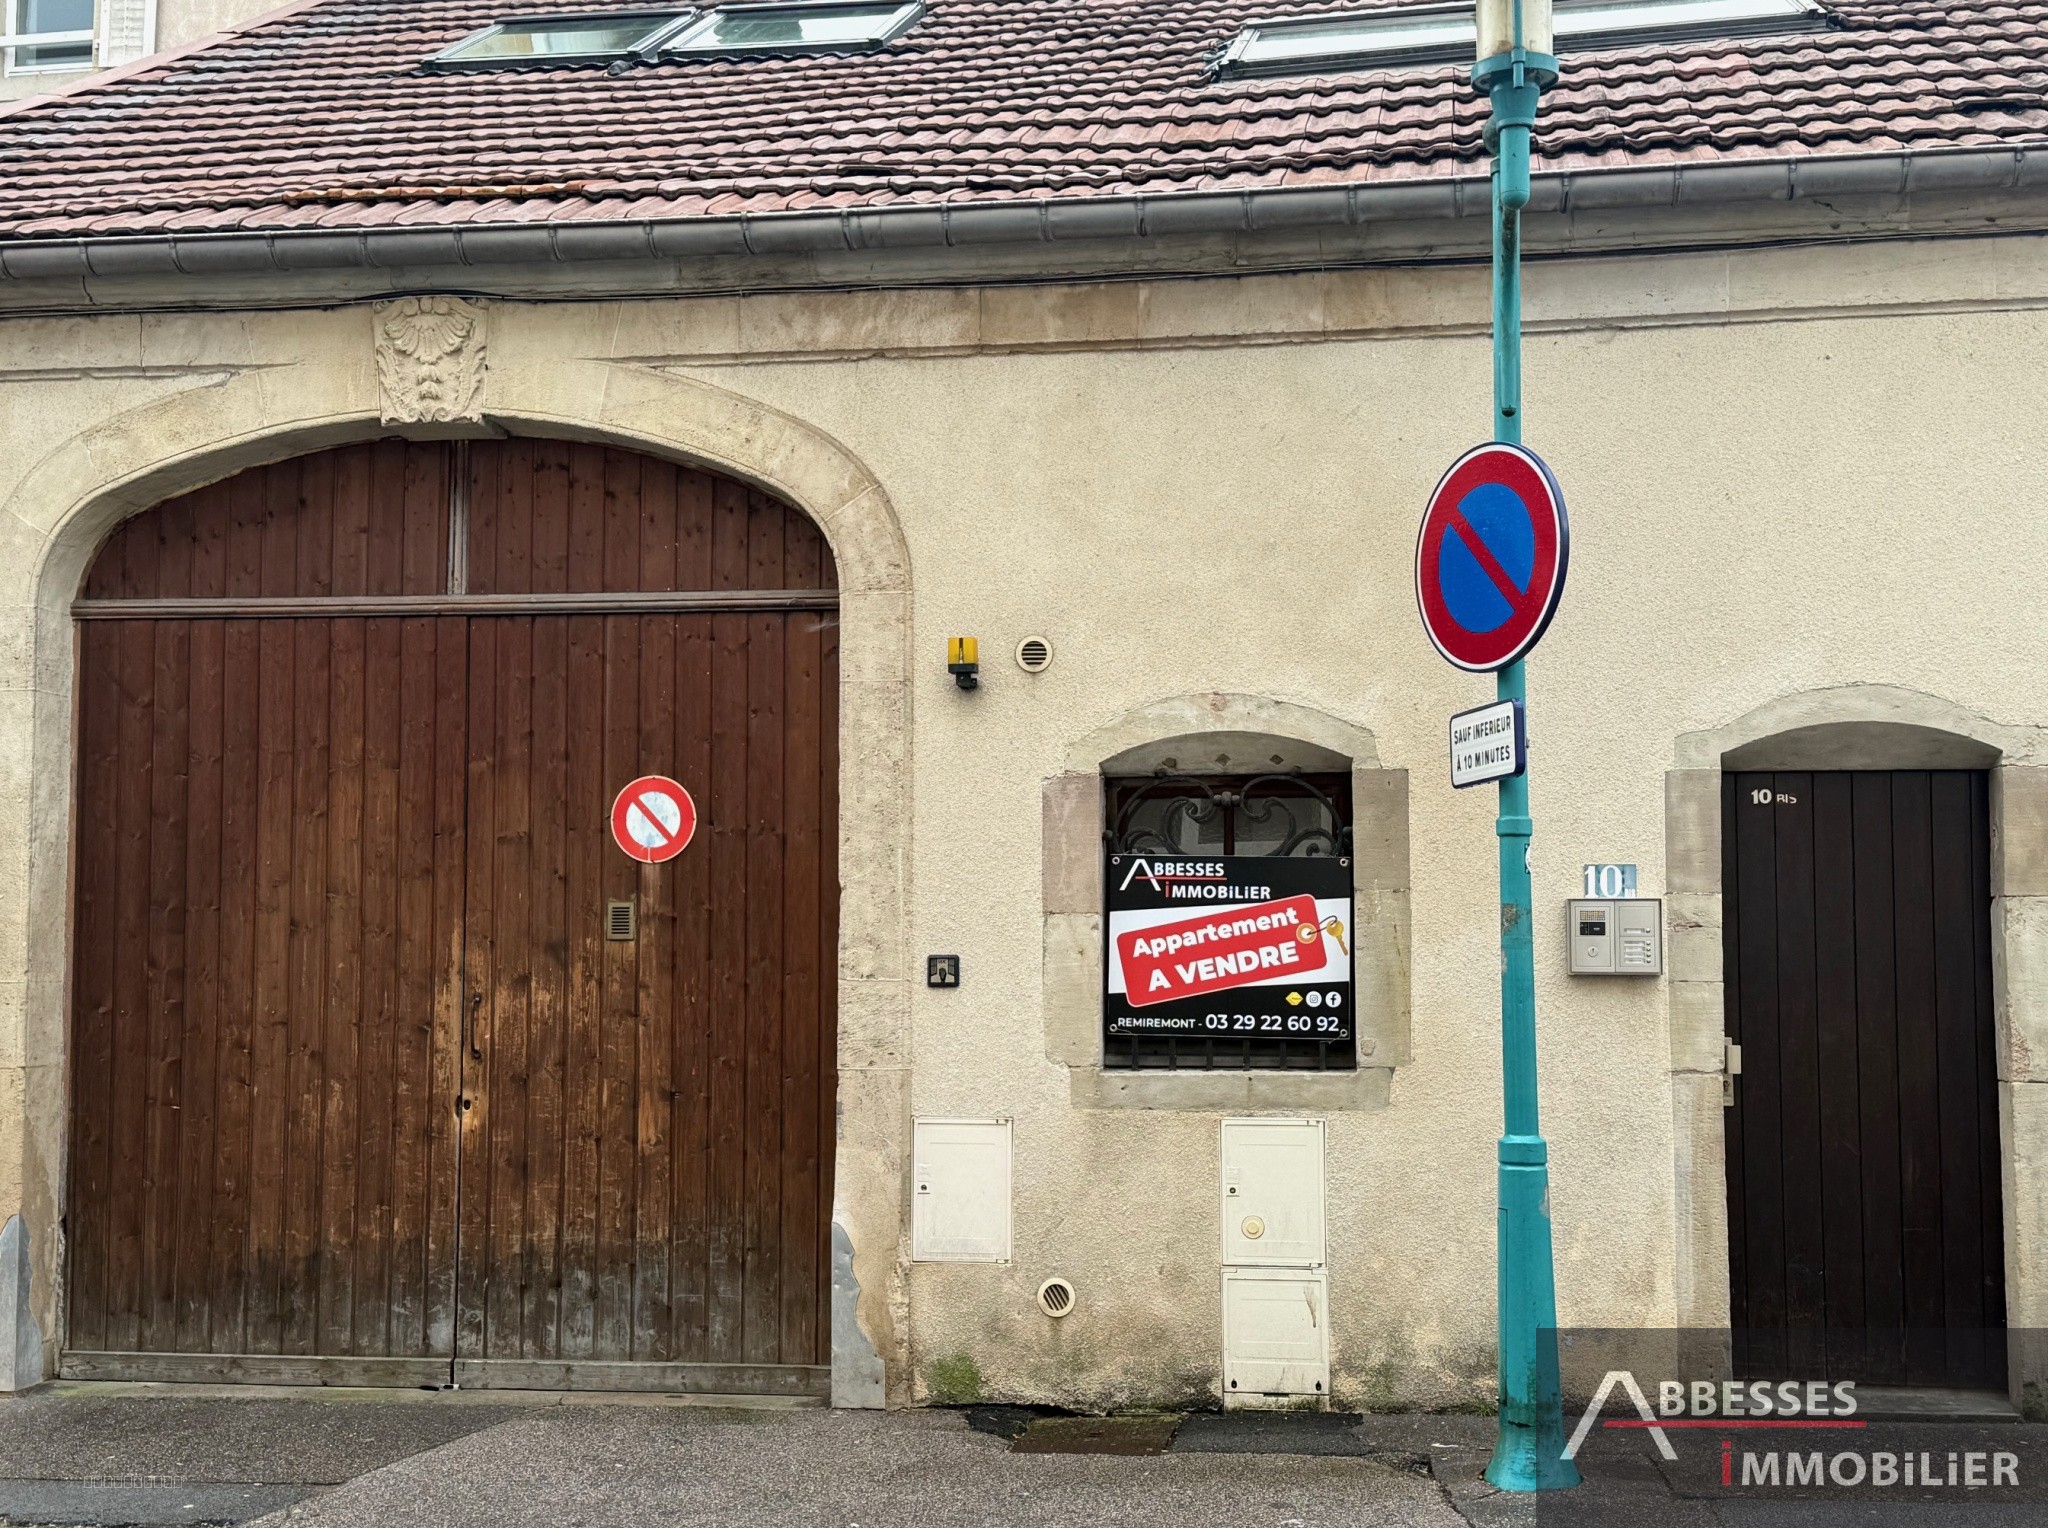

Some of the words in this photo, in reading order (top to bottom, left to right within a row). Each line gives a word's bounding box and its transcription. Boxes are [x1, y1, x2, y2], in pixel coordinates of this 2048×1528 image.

[1454, 726, 1472, 745] SAUF
[1473, 715, 1511, 740] INFERIEUR
[1464, 754, 1472, 770] 10
[1475, 744, 1510, 767] MINUTES
[1751, 788, 1772, 804] 10
[1119, 858, 1227, 891] ABBESSES
[1132, 908, 1299, 957] Appartement
[1148, 968, 1171, 992] A
[1174, 941, 1300, 985] VENDRE
[1117, 1017, 1196, 1029] REMIREMONT
[1205, 1013, 1229, 1030] 03
[1233, 1014, 1256, 1030] 29
[1260, 1015, 1283, 1031] 22
[1287, 1016, 1312, 1031] 60
[1316, 1016, 1340, 1032] 92
